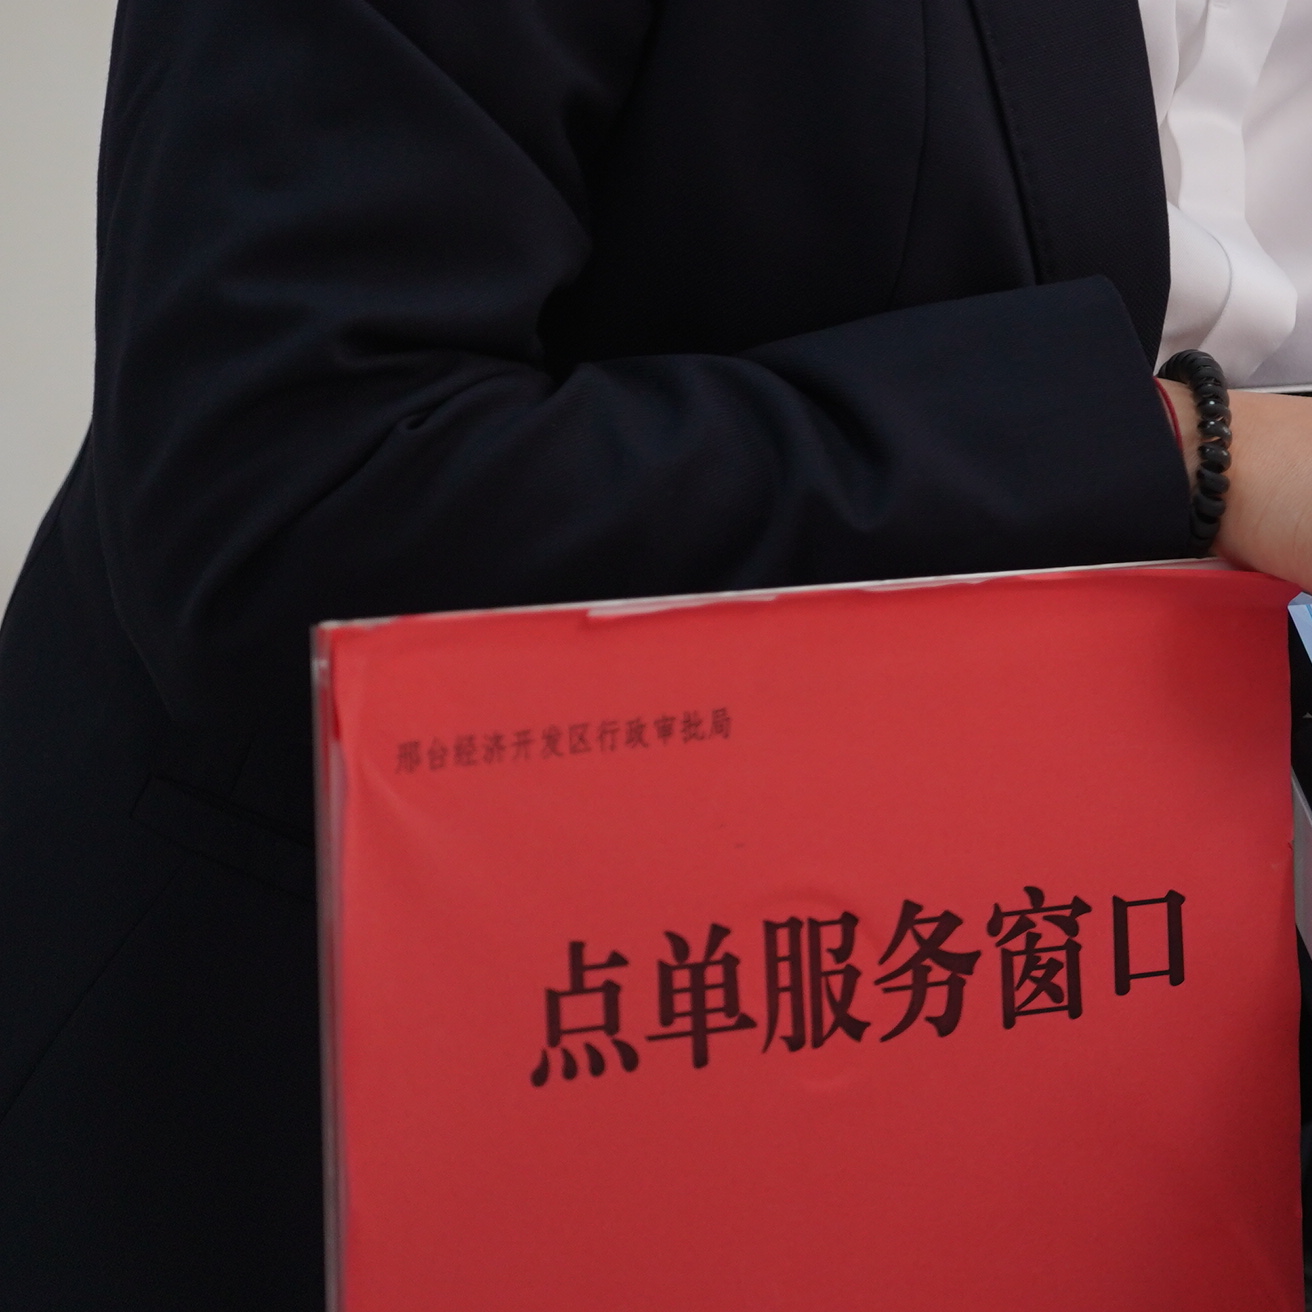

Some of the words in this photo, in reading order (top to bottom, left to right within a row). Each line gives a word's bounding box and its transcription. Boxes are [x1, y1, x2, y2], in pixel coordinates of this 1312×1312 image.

[396, 706, 733, 774] 邢台经济开发区行政审批局
[530, 885, 1187, 1089] 点单服务窗口
